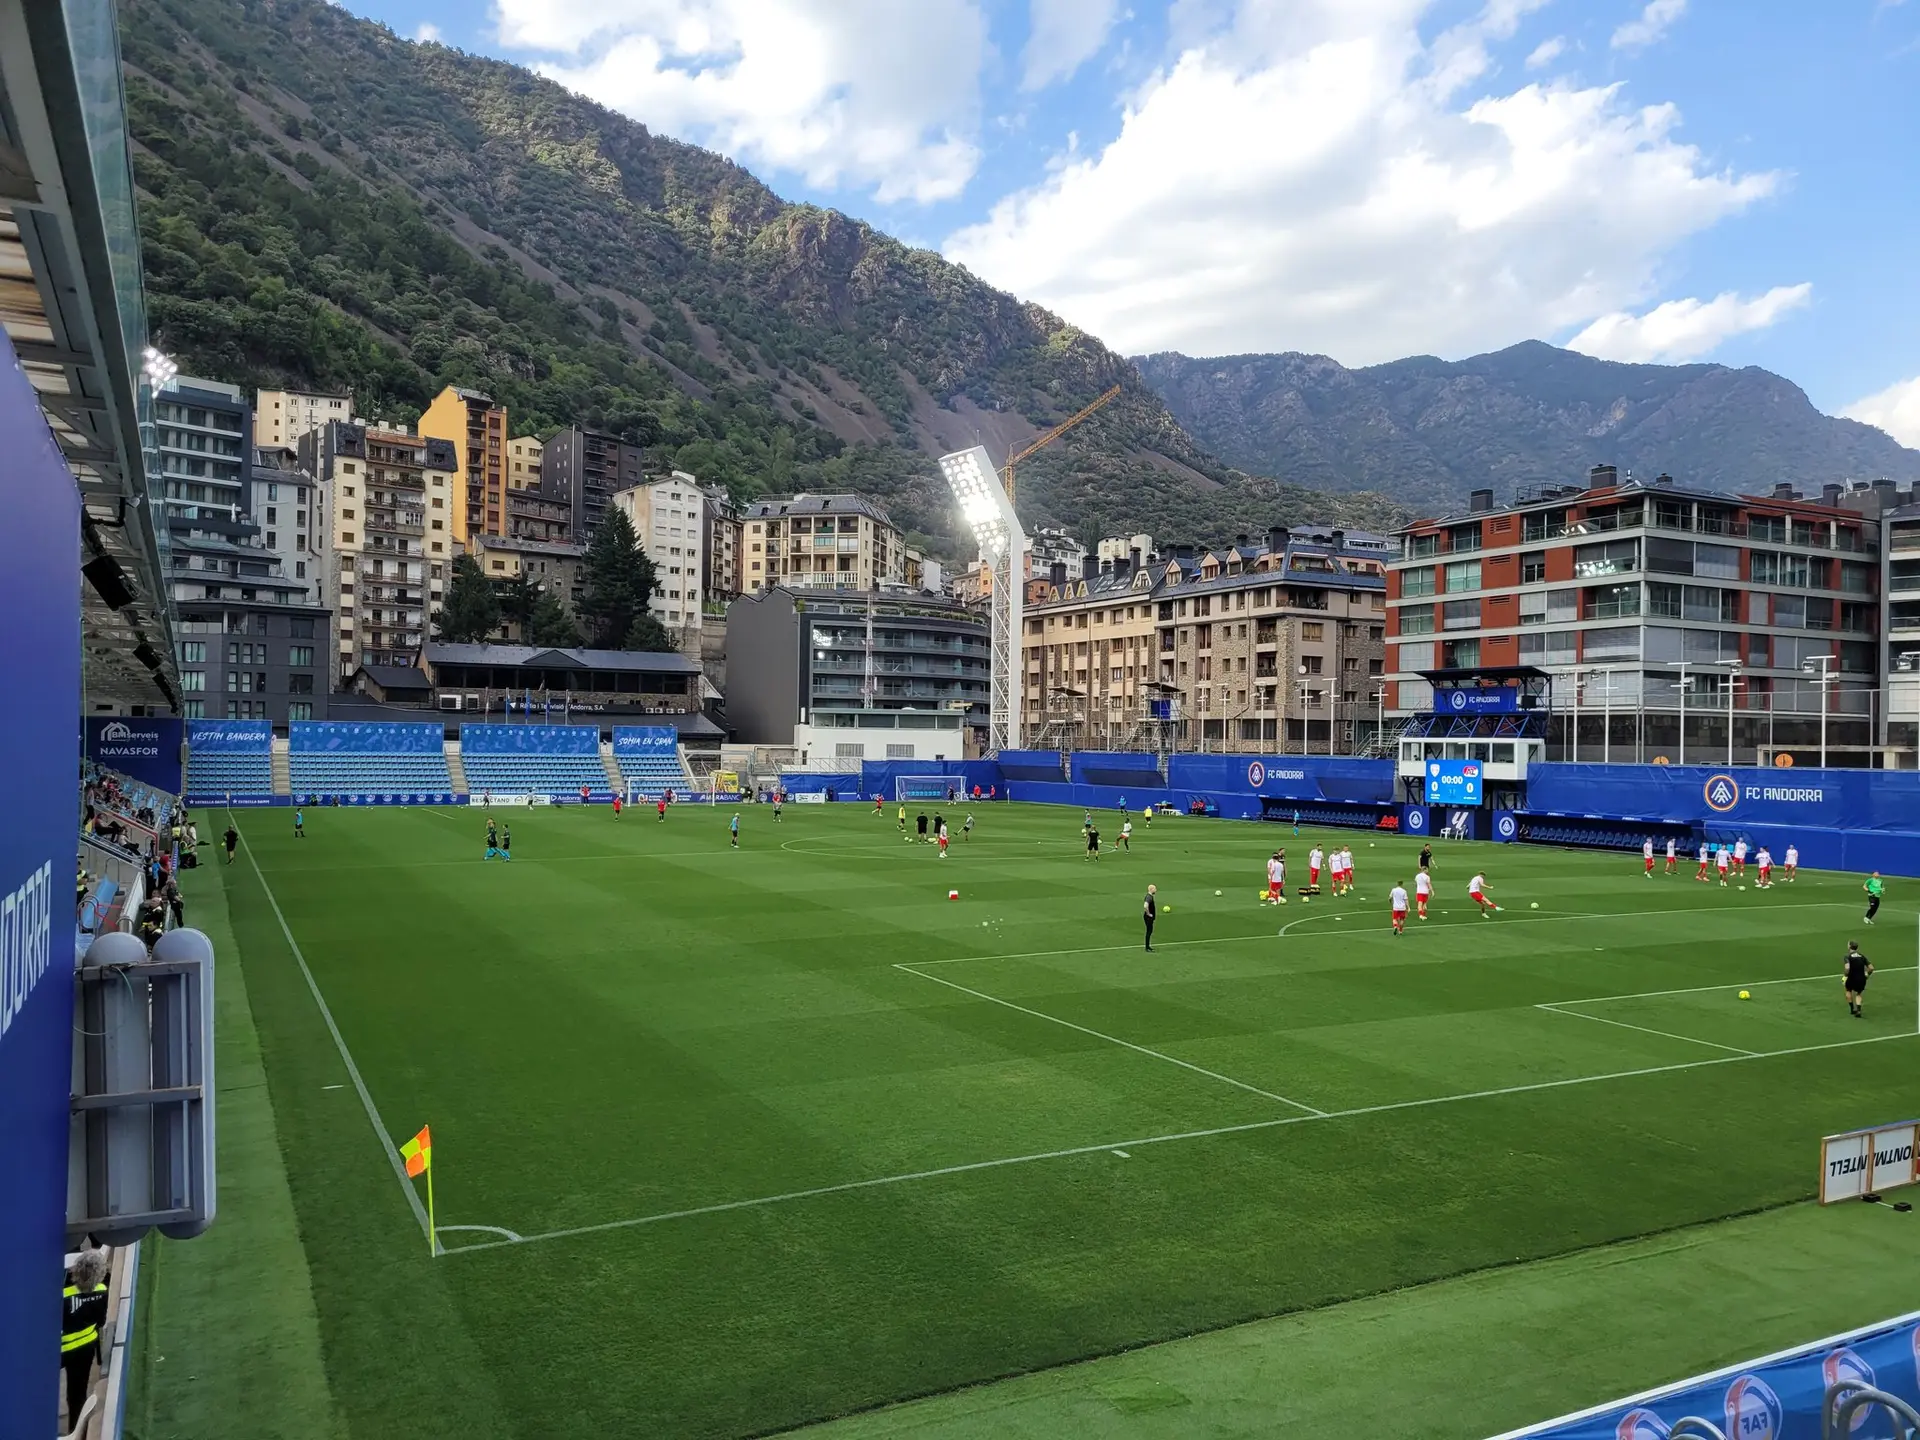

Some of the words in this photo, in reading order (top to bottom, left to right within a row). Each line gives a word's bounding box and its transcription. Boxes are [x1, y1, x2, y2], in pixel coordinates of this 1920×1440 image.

[192, 732, 224, 741] VESTIM
[226, 732, 266, 741] BANDERA
[617, 737, 641, 746] SOMIA
[642, 738, 653, 746] EN
[654, 737, 673, 746] GRAN
[100, 747, 158, 755] NAVASFOR
[1267, 769, 1276, 779] FC
[1276, 769, 1304, 780] ANDORRA
[1441, 775, 1463, 785] 00:00
[1431, 781, 1438, 792] 0
[1466, 782, 1474, 793] 0
[1746, 787, 1761, 800] FC
[1763, 787, 1823, 802] ANDORRA
